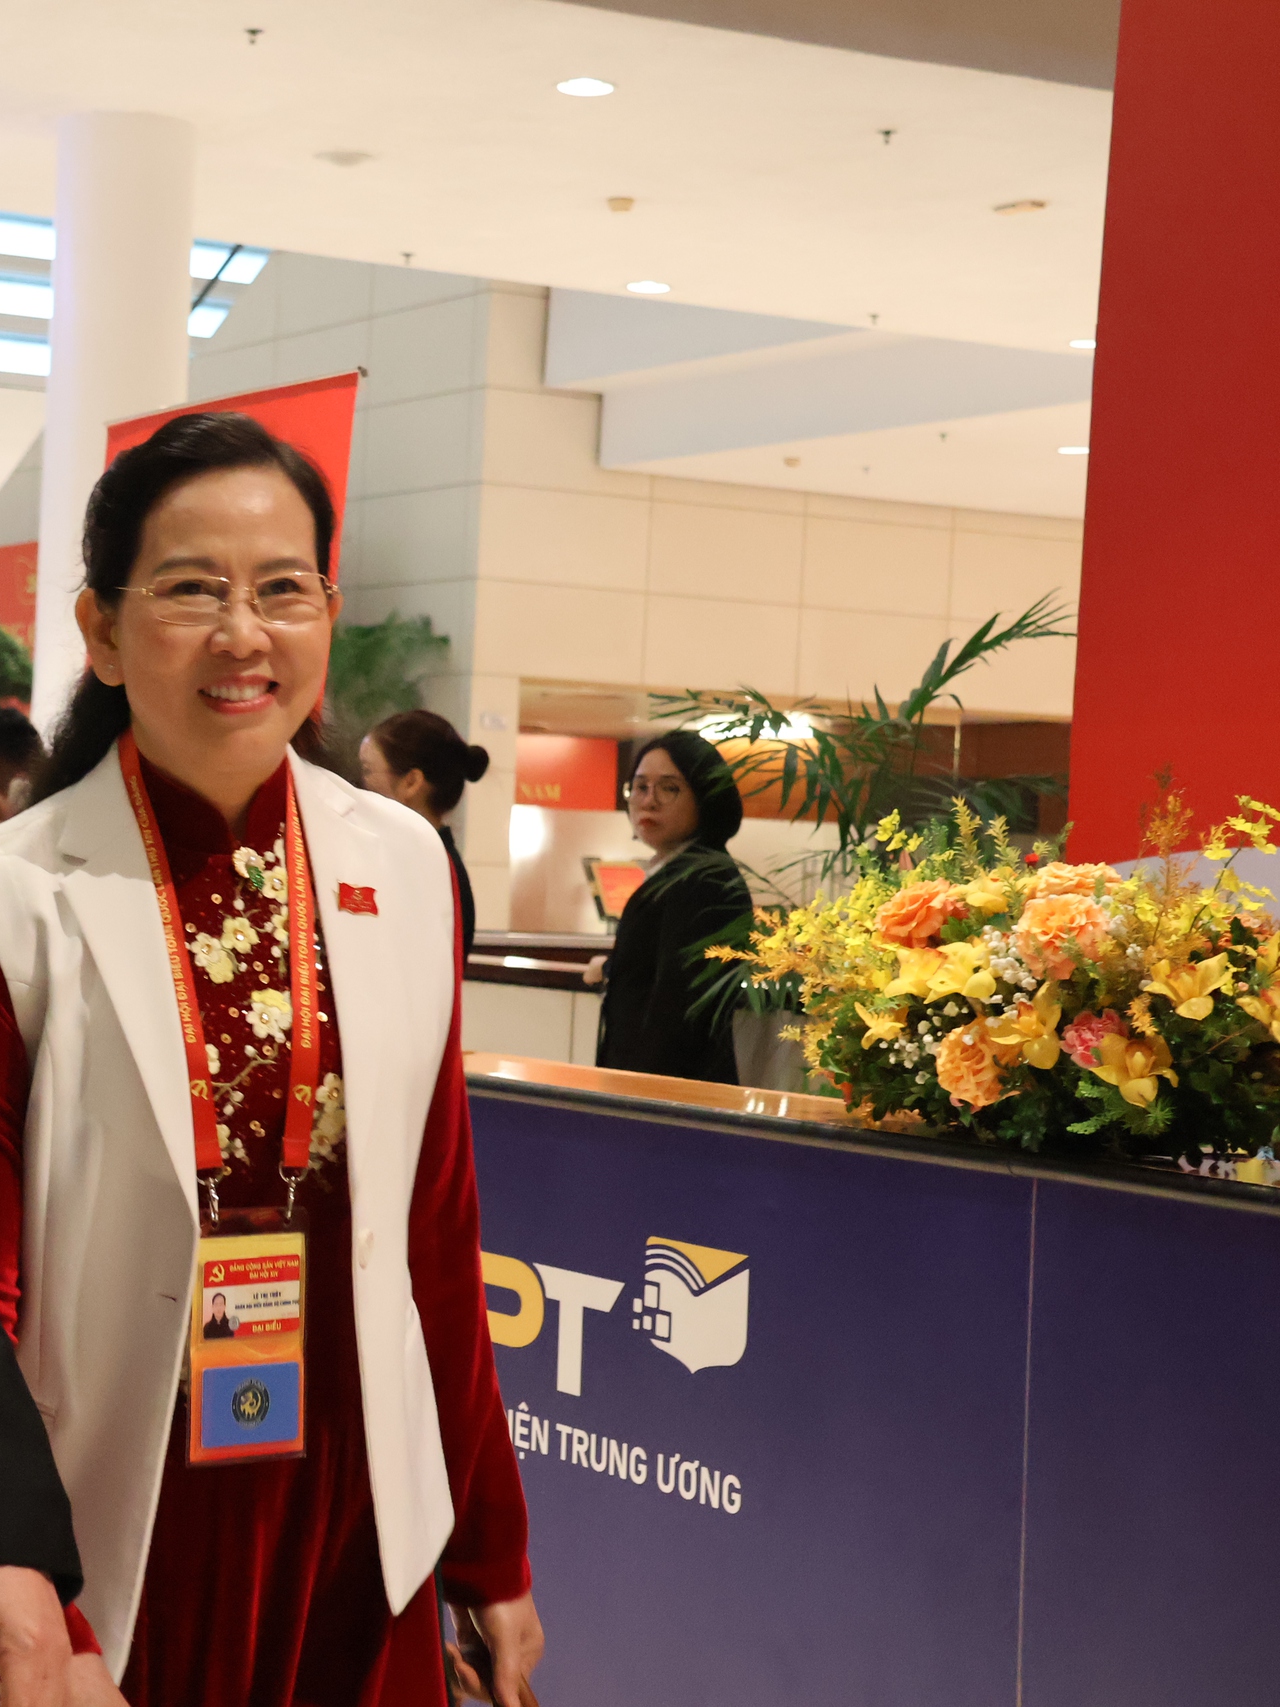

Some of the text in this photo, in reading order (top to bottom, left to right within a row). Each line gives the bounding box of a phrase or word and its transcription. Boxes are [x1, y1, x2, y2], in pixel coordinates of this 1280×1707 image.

[295, 899, 308, 930] QUỐC
[296, 931, 309, 960] TOÀN
[296, 961, 310, 985] BIỂU
[175, 981, 189, 1001] ĐẠI
[299, 986, 313, 1006] ĐẠI
[179, 1002, 193, 1022] HỘI
[299, 1007, 313, 1028] HỘI
[183, 1023, 197, 1044] ĐẠI
[300, 1029, 314, 1049] ĐẠI
[252, 1319, 282, 1333] ĐẠI BIỂU
[556, 1422, 648, 1485] TRUNG
[656, 1453, 742, 1514] ƯƠNG
